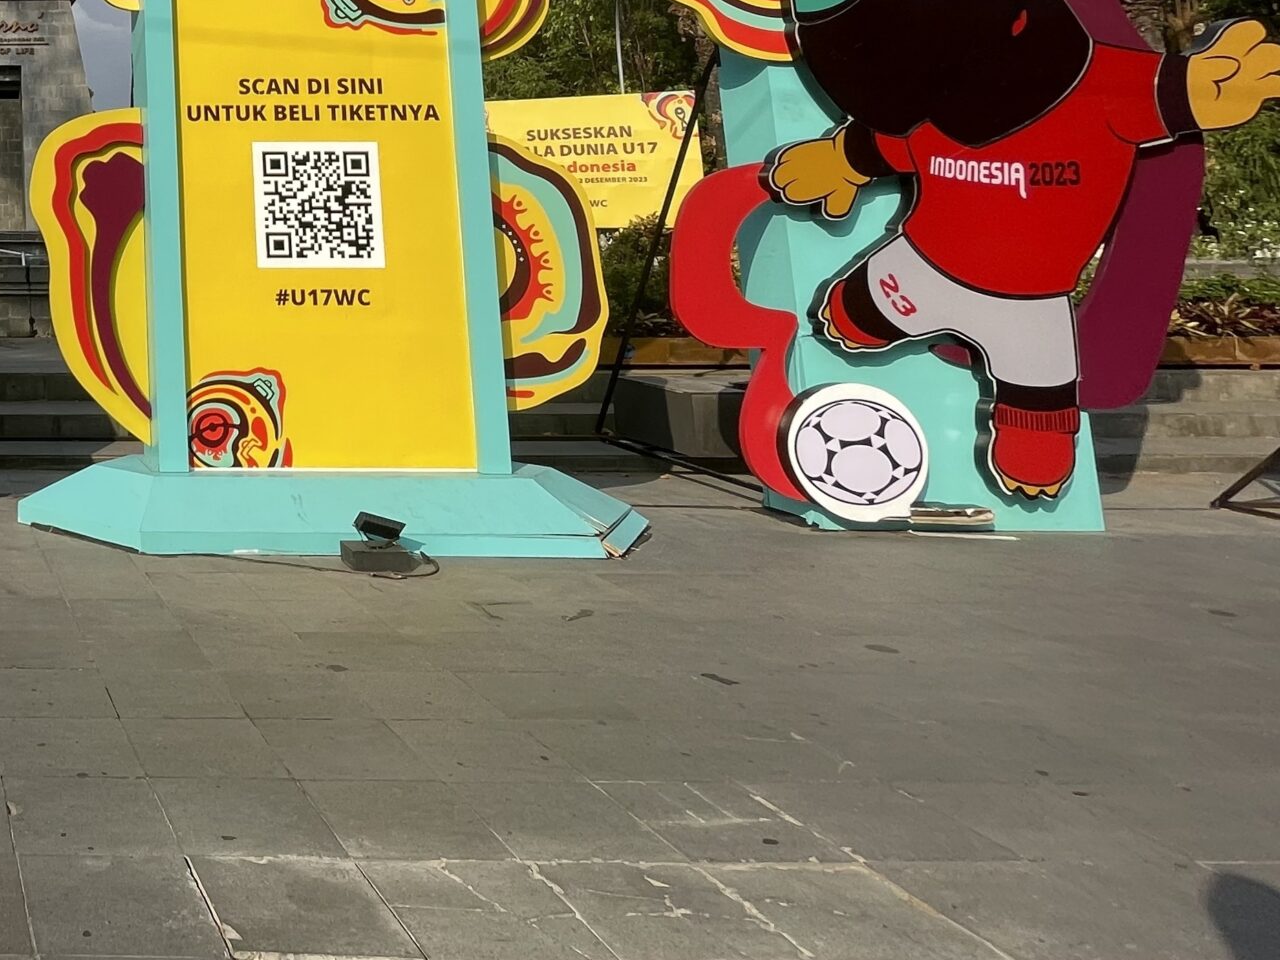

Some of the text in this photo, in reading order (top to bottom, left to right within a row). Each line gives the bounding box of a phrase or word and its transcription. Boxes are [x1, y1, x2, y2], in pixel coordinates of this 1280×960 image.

[238, 77, 383, 96] SCAN DI SINI
[186, 103, 441, 122] UNTUK BELI TIKETNYA
[526, 125, 632, 142] SUKSESKAN
[560, 143, 618, 157] DUNIA
[622, 141, 658, 155] U17
[585, 176, 627, 184] DESEMBER
[930, 155, 1081, 200] INDONESIA 2023
[275, 288, 371, 307] #U17WC
[879, 273, 917, 317] 23
